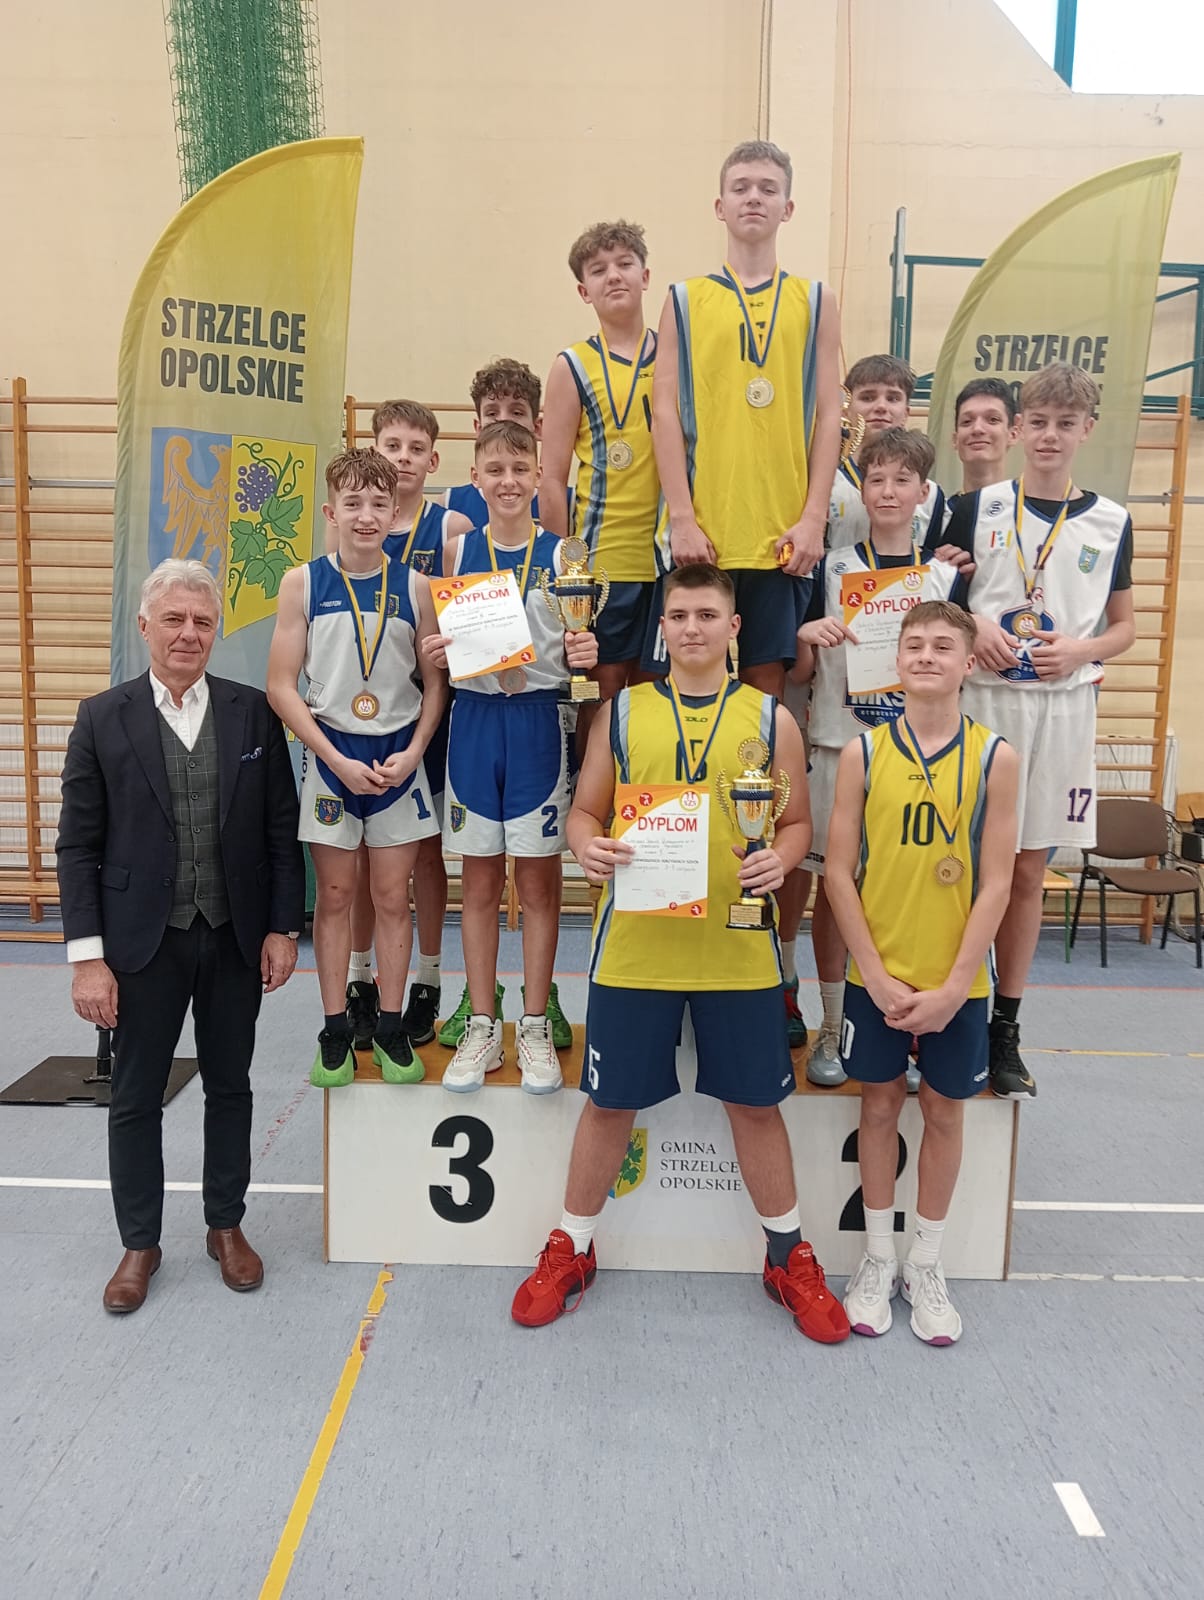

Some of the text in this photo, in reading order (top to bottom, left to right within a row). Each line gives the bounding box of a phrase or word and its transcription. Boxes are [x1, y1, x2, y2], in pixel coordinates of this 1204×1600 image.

[161, 298, 306, 354] STRZELCE
[160, 348, 304, 403] OPOLSKIE
[455, 588, 510, 605] DYPLOM
[864, 596, 921, 615] DYPLOM
[411, 788, 431, 820] 1
[1067, 788, 1092, 822] 17
[541, 805, 559, 837] 2
[638, 817, 698, 832] DYPLOM
[901, 801, 935, 846] 10
[661, 1141, 716, 1154] GMINA
[429, 1115, 495, 1223] 3
[660, 1159, 741, 1173] STRZELCE
[660, 1177, 743, 1191] OPOLSKIE
